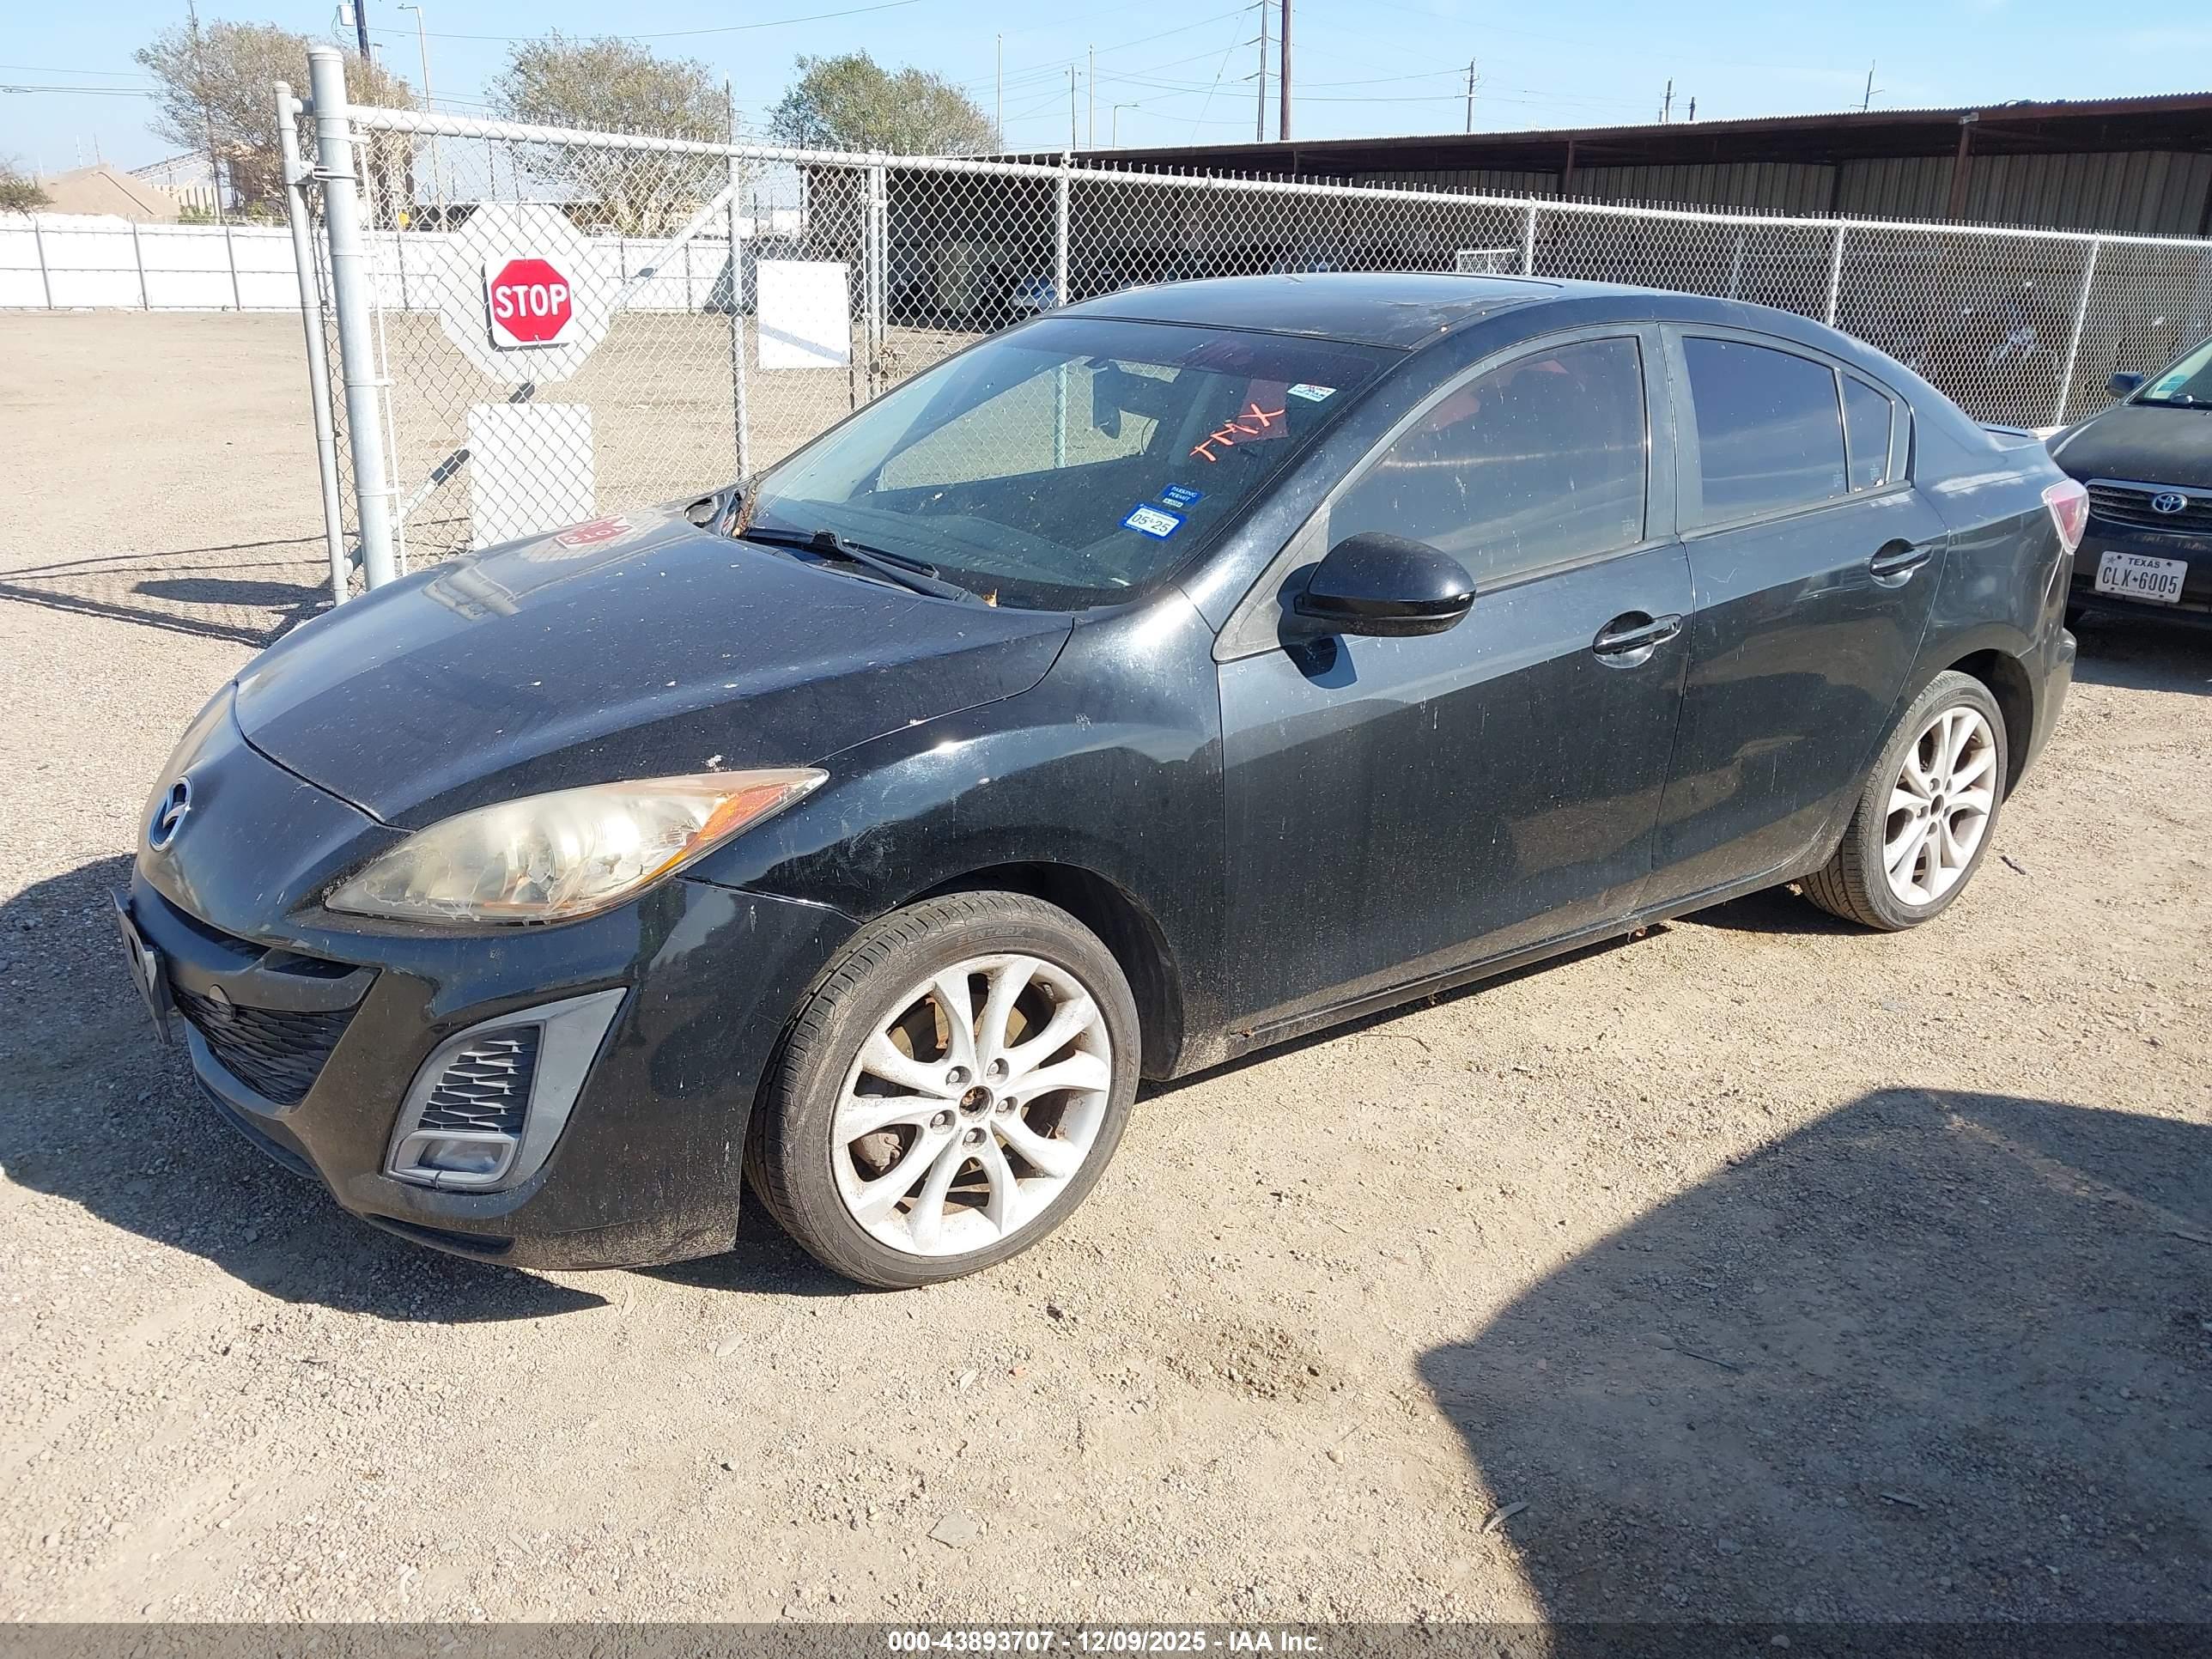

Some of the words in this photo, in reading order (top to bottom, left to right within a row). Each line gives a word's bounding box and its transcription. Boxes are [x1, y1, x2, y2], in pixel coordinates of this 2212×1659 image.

[495, 283, 568, 319] STOP
[1168, 492, 1192, 501] PERMIT
[1170, 486, 1198, 498] PARKING
[2128, 557, 2160, 568] TEXAS
